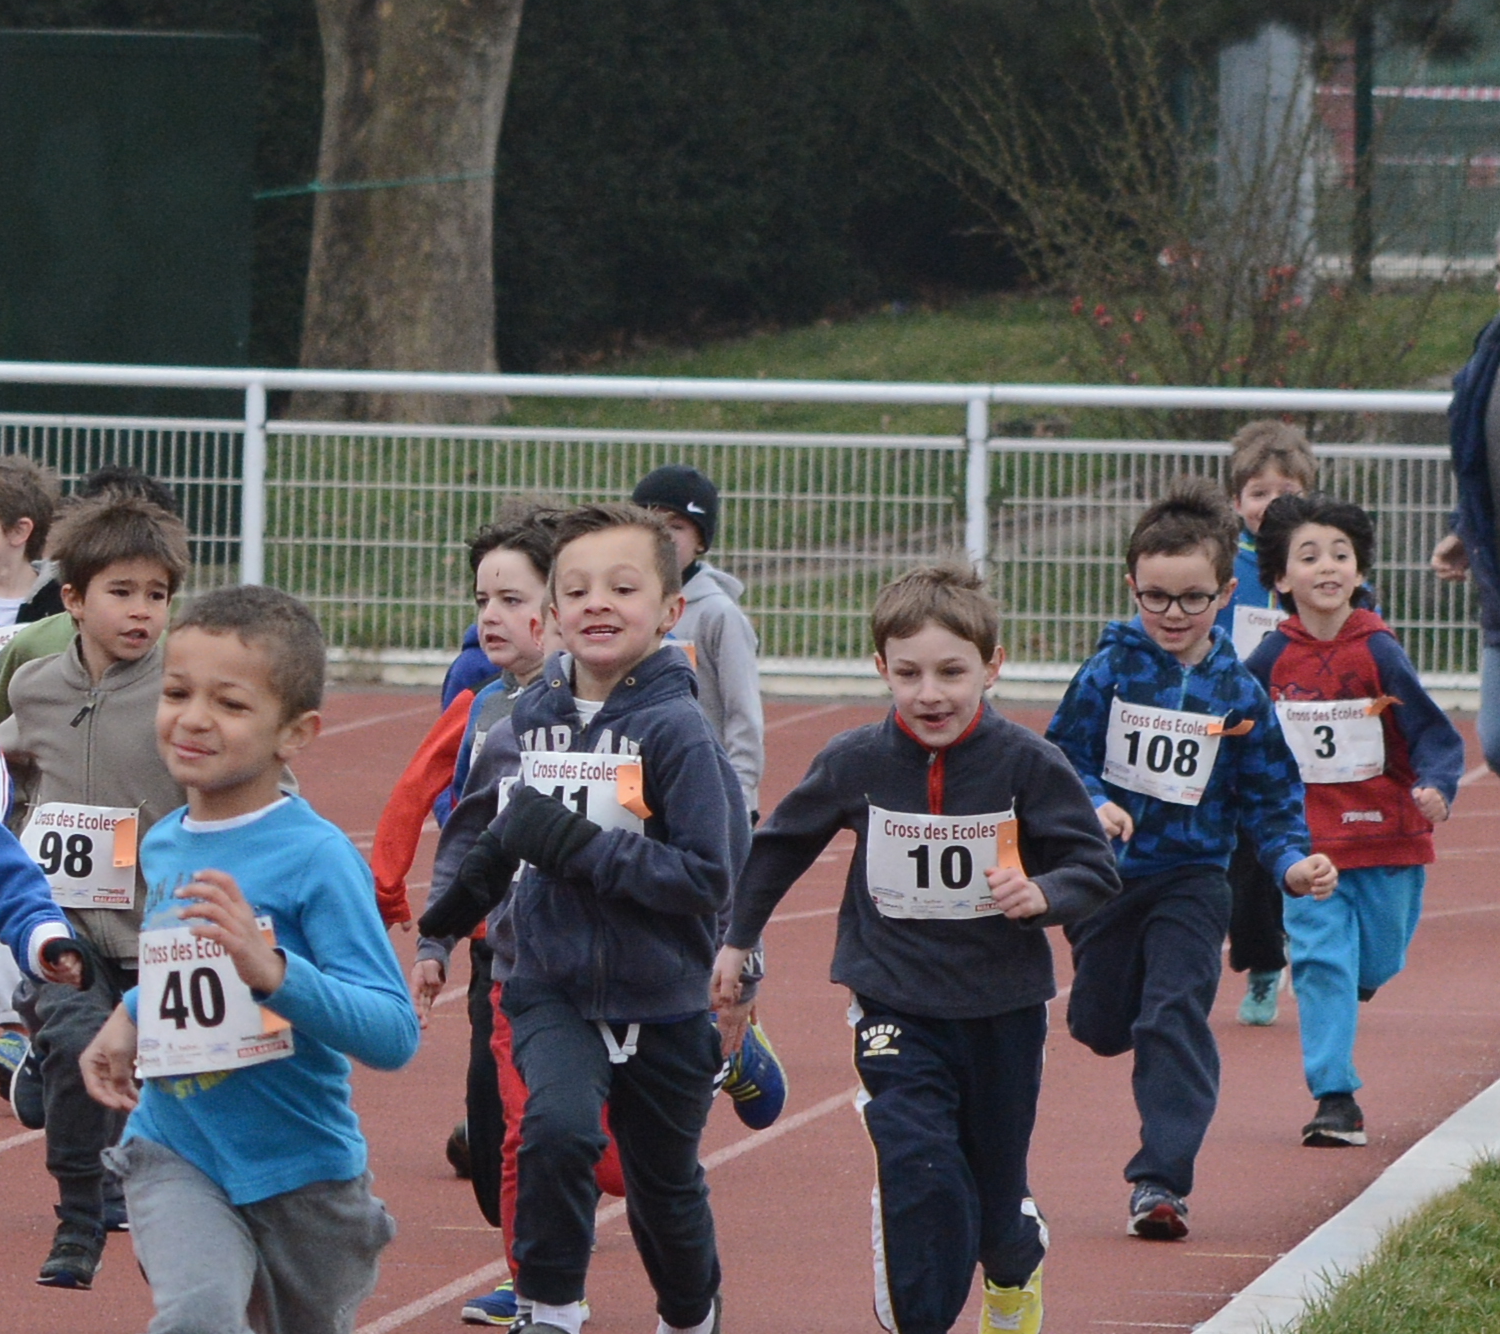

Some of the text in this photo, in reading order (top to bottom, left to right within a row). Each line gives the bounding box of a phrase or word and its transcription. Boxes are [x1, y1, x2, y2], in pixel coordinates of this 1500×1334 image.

[1121, 710, 1208, 737] Cross des Ecoles
[1286, 707, 1364, 722] Cross des Ecoles
[1124, 730, 1200, 778] 108
[1313, 725, 1336, 759] 3
[532, 759, 618, 781] Cross des Ecoles
[35, 810, 117, 832] Cross des Ecoles
[885, 820, 996, 840] Cross des Ecoles
[38, 830, 93, 878] 98
[907, 844, 973, 890] 10
[143, 942, 168, 965] Cross
[171, 938, 192, 962] des
[159, 967, 226, 1030] 40
